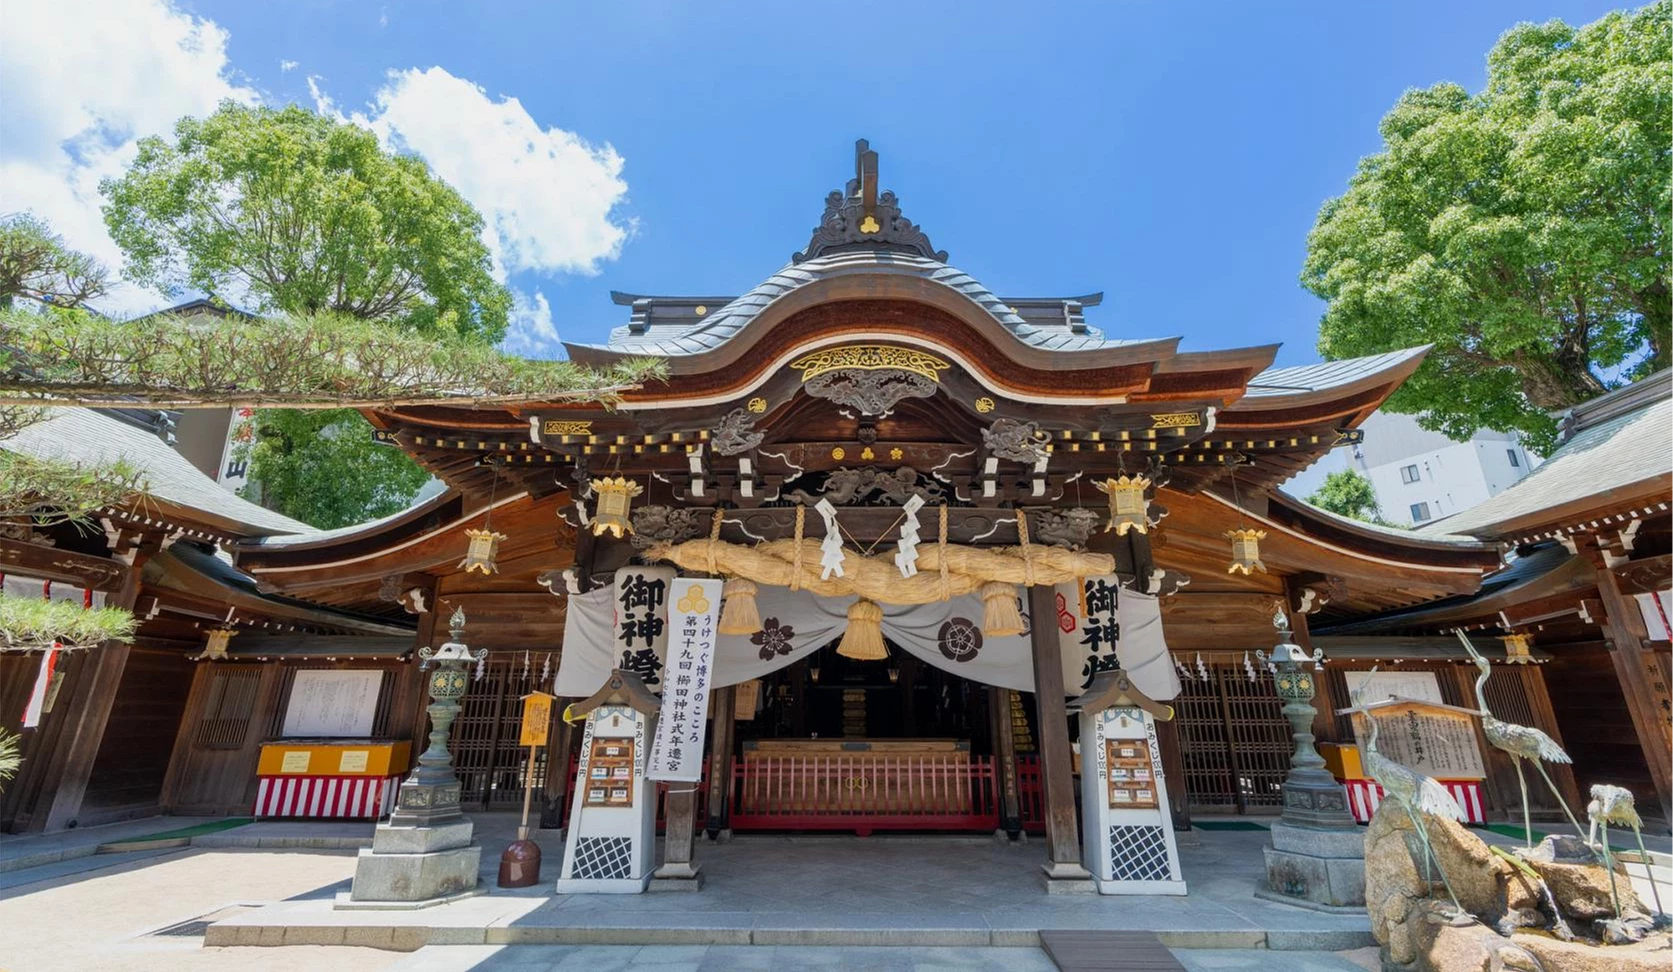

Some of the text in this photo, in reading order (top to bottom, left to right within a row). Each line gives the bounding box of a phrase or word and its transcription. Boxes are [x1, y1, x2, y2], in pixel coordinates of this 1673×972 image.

[689, 614, 712, 743] うけつぐ博多のこころ
